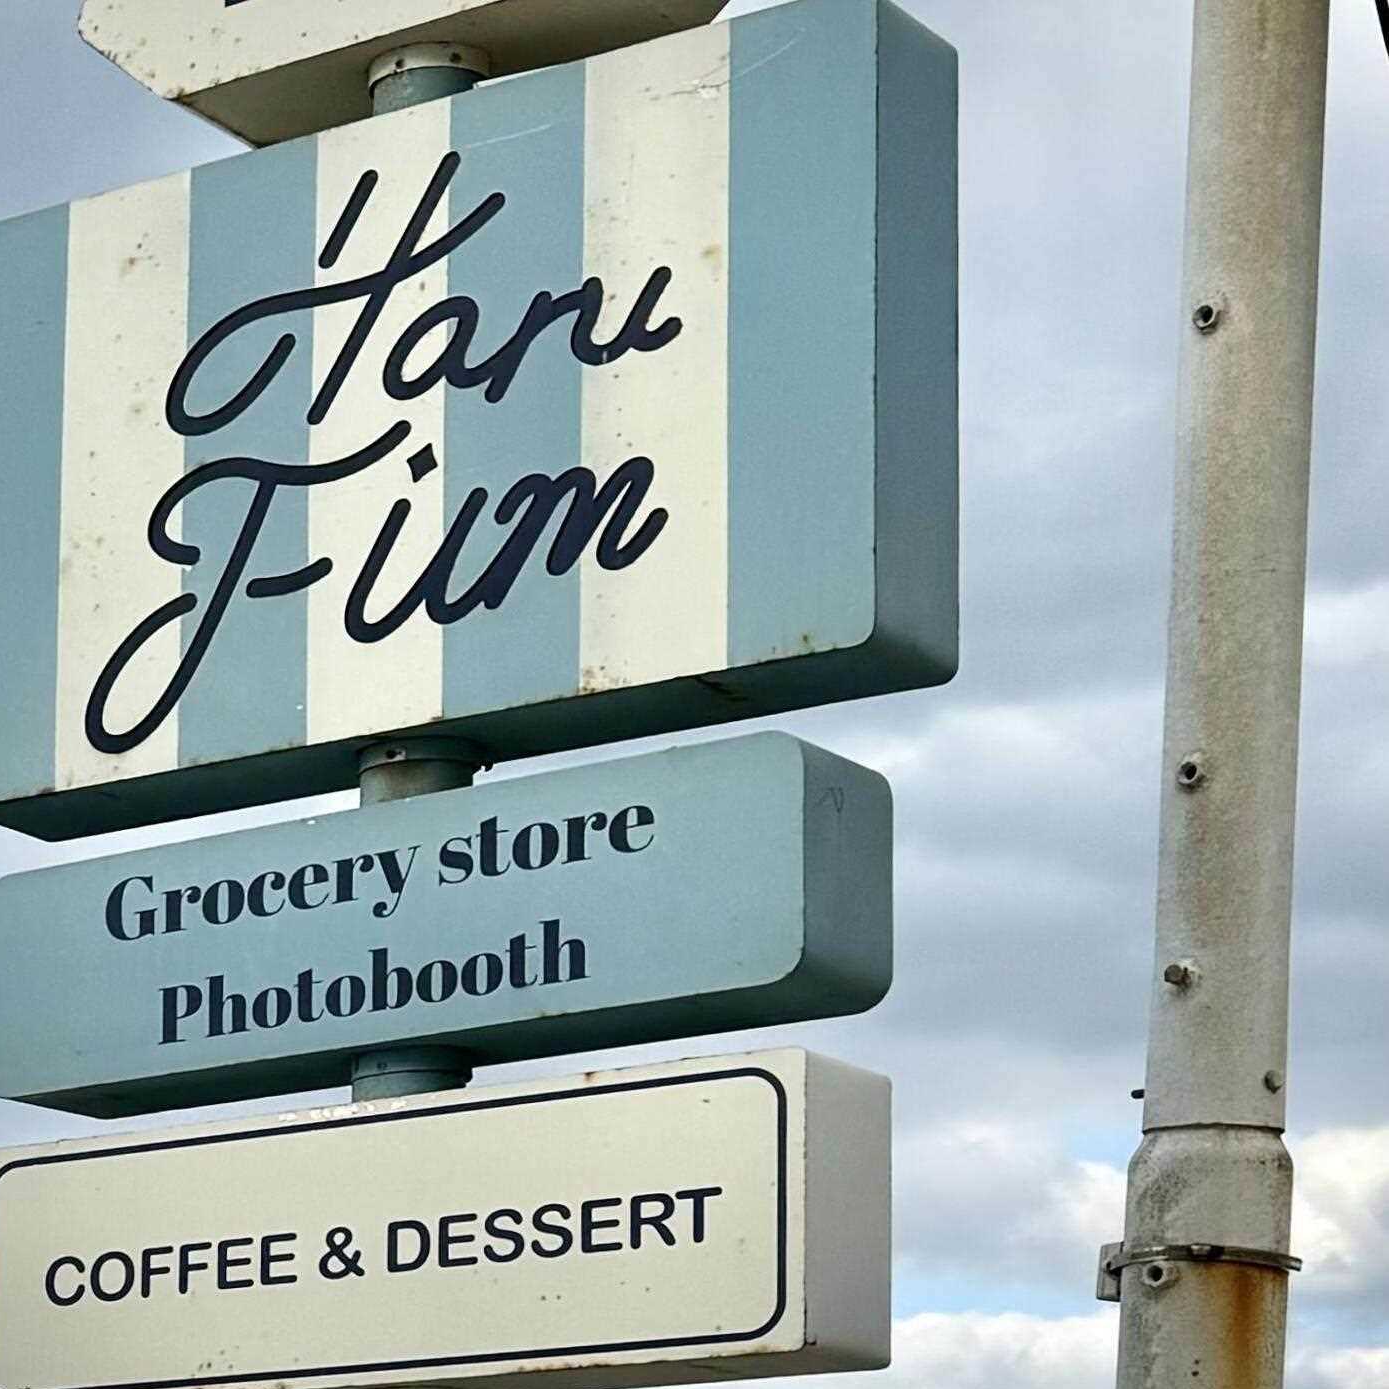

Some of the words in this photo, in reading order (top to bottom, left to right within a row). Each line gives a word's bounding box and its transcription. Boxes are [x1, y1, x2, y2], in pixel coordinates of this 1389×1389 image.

[106, 845, 421, 941] Grocery
[438, 804, 655, 886] store
[158, 919, 588, 1044] Photobooth
[45, 1232, 298, 1307] COFFEE
[318, 1226, 365, 1280] &
[388, 1187, 723, 1273] DESSERT
